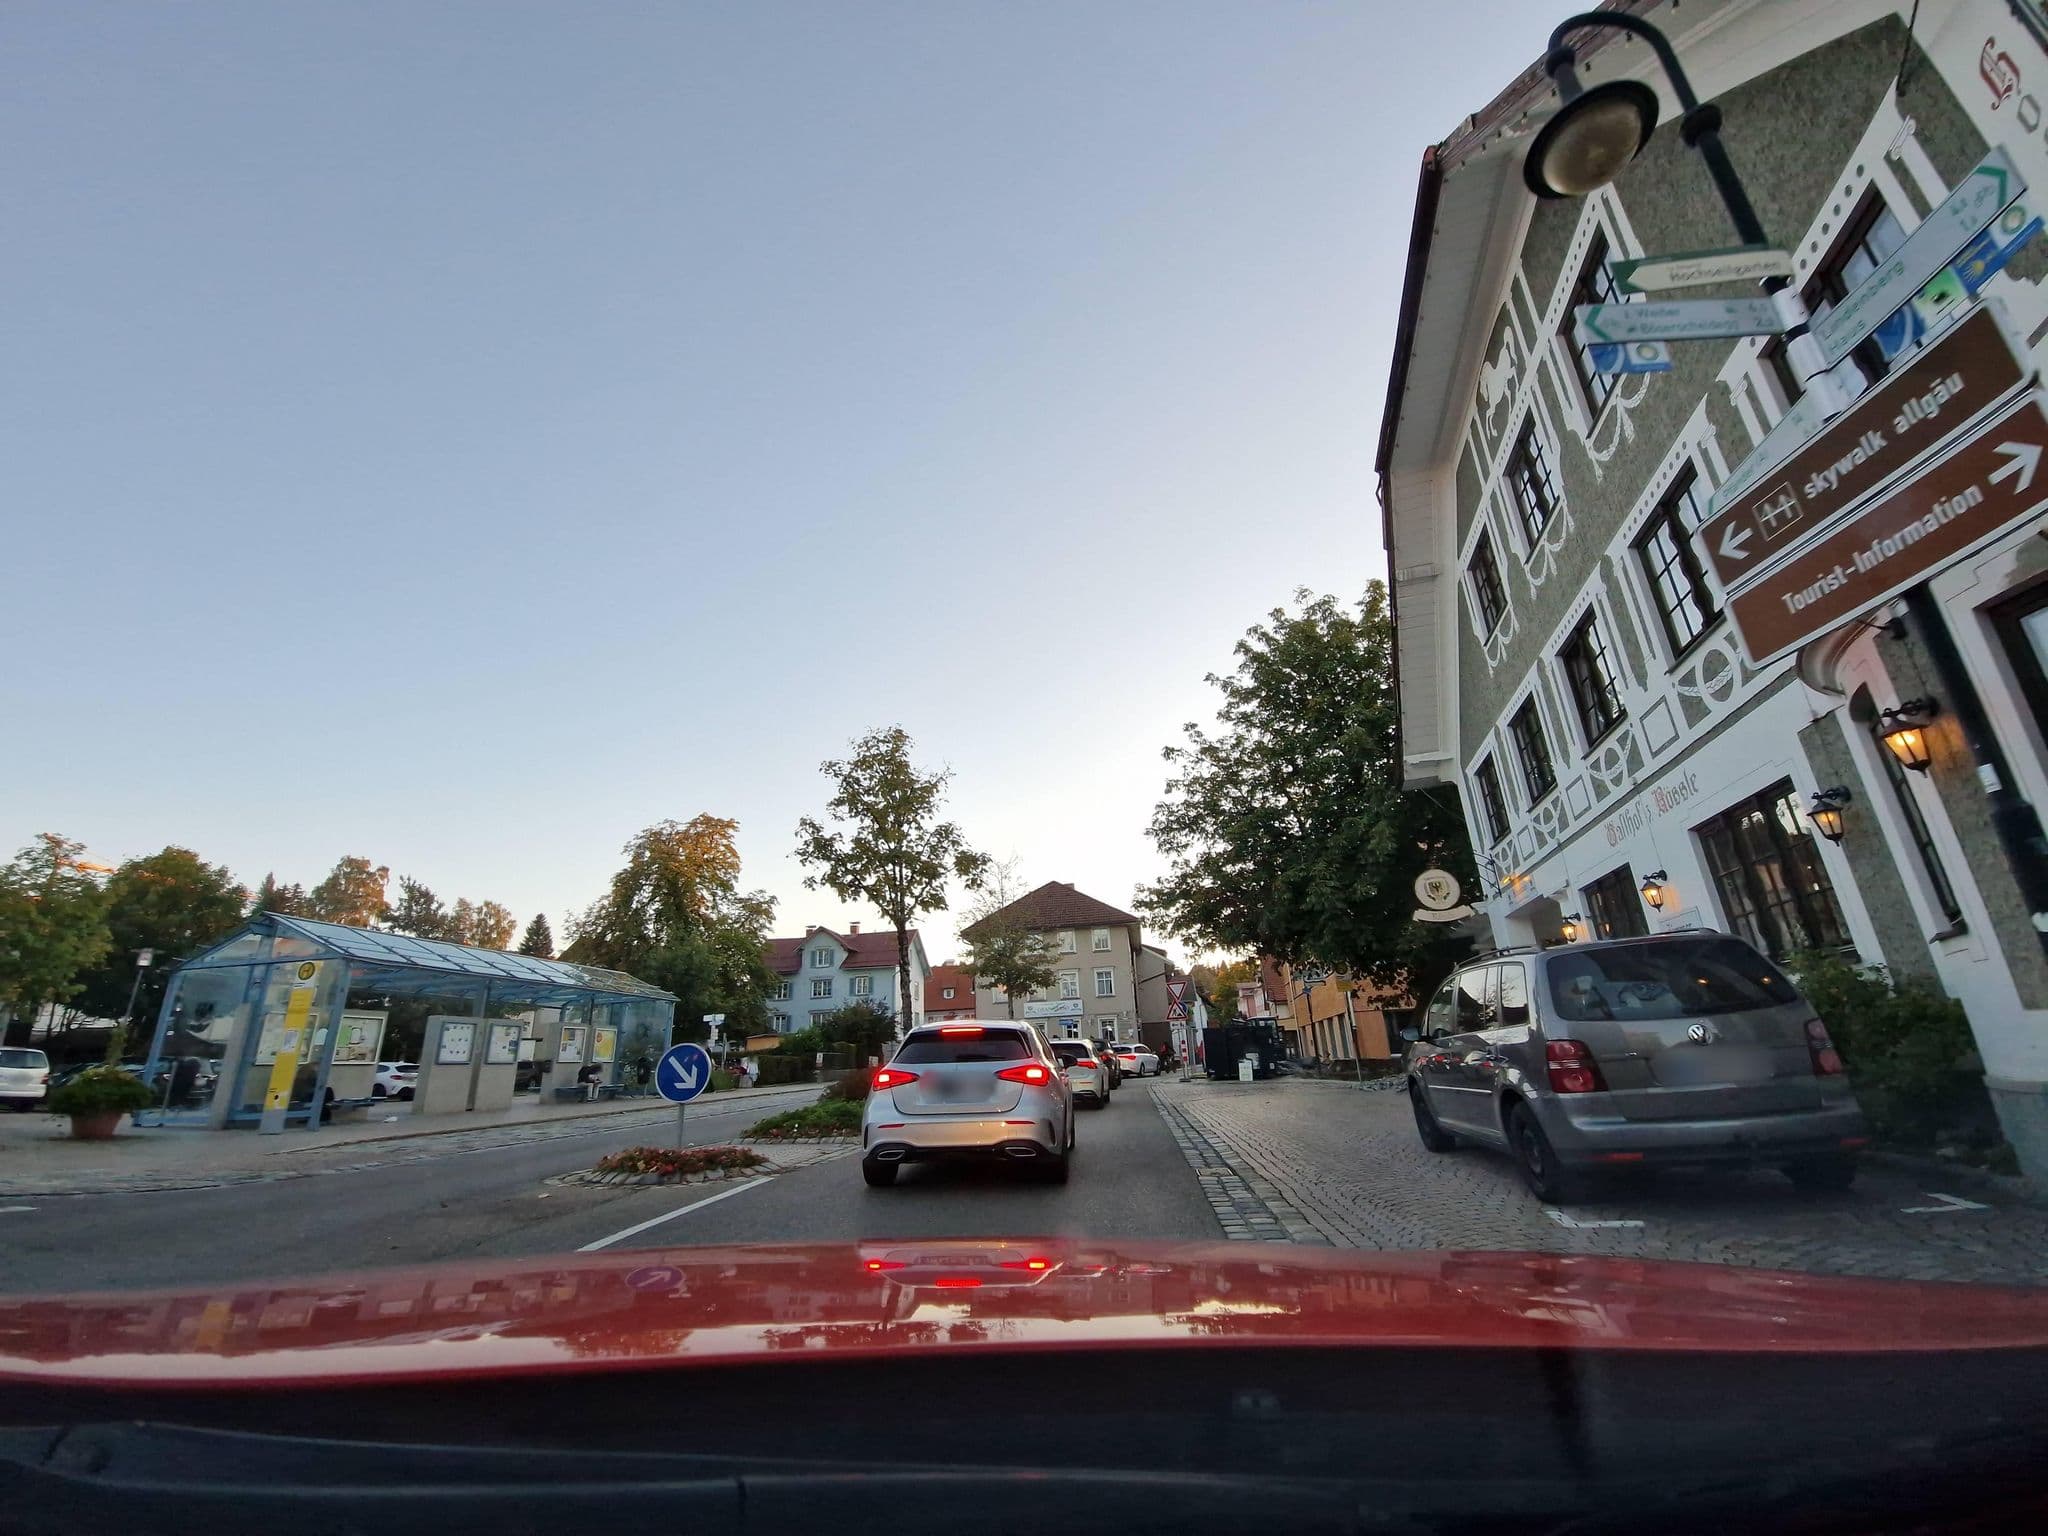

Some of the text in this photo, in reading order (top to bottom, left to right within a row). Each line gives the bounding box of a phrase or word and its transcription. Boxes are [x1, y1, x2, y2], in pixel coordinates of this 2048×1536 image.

[1804, 428, 1888, 499] skywalk
[1893, 371, 1966, 436] allgäu
[1781, 484, 1984, 615] Tourist-Information
